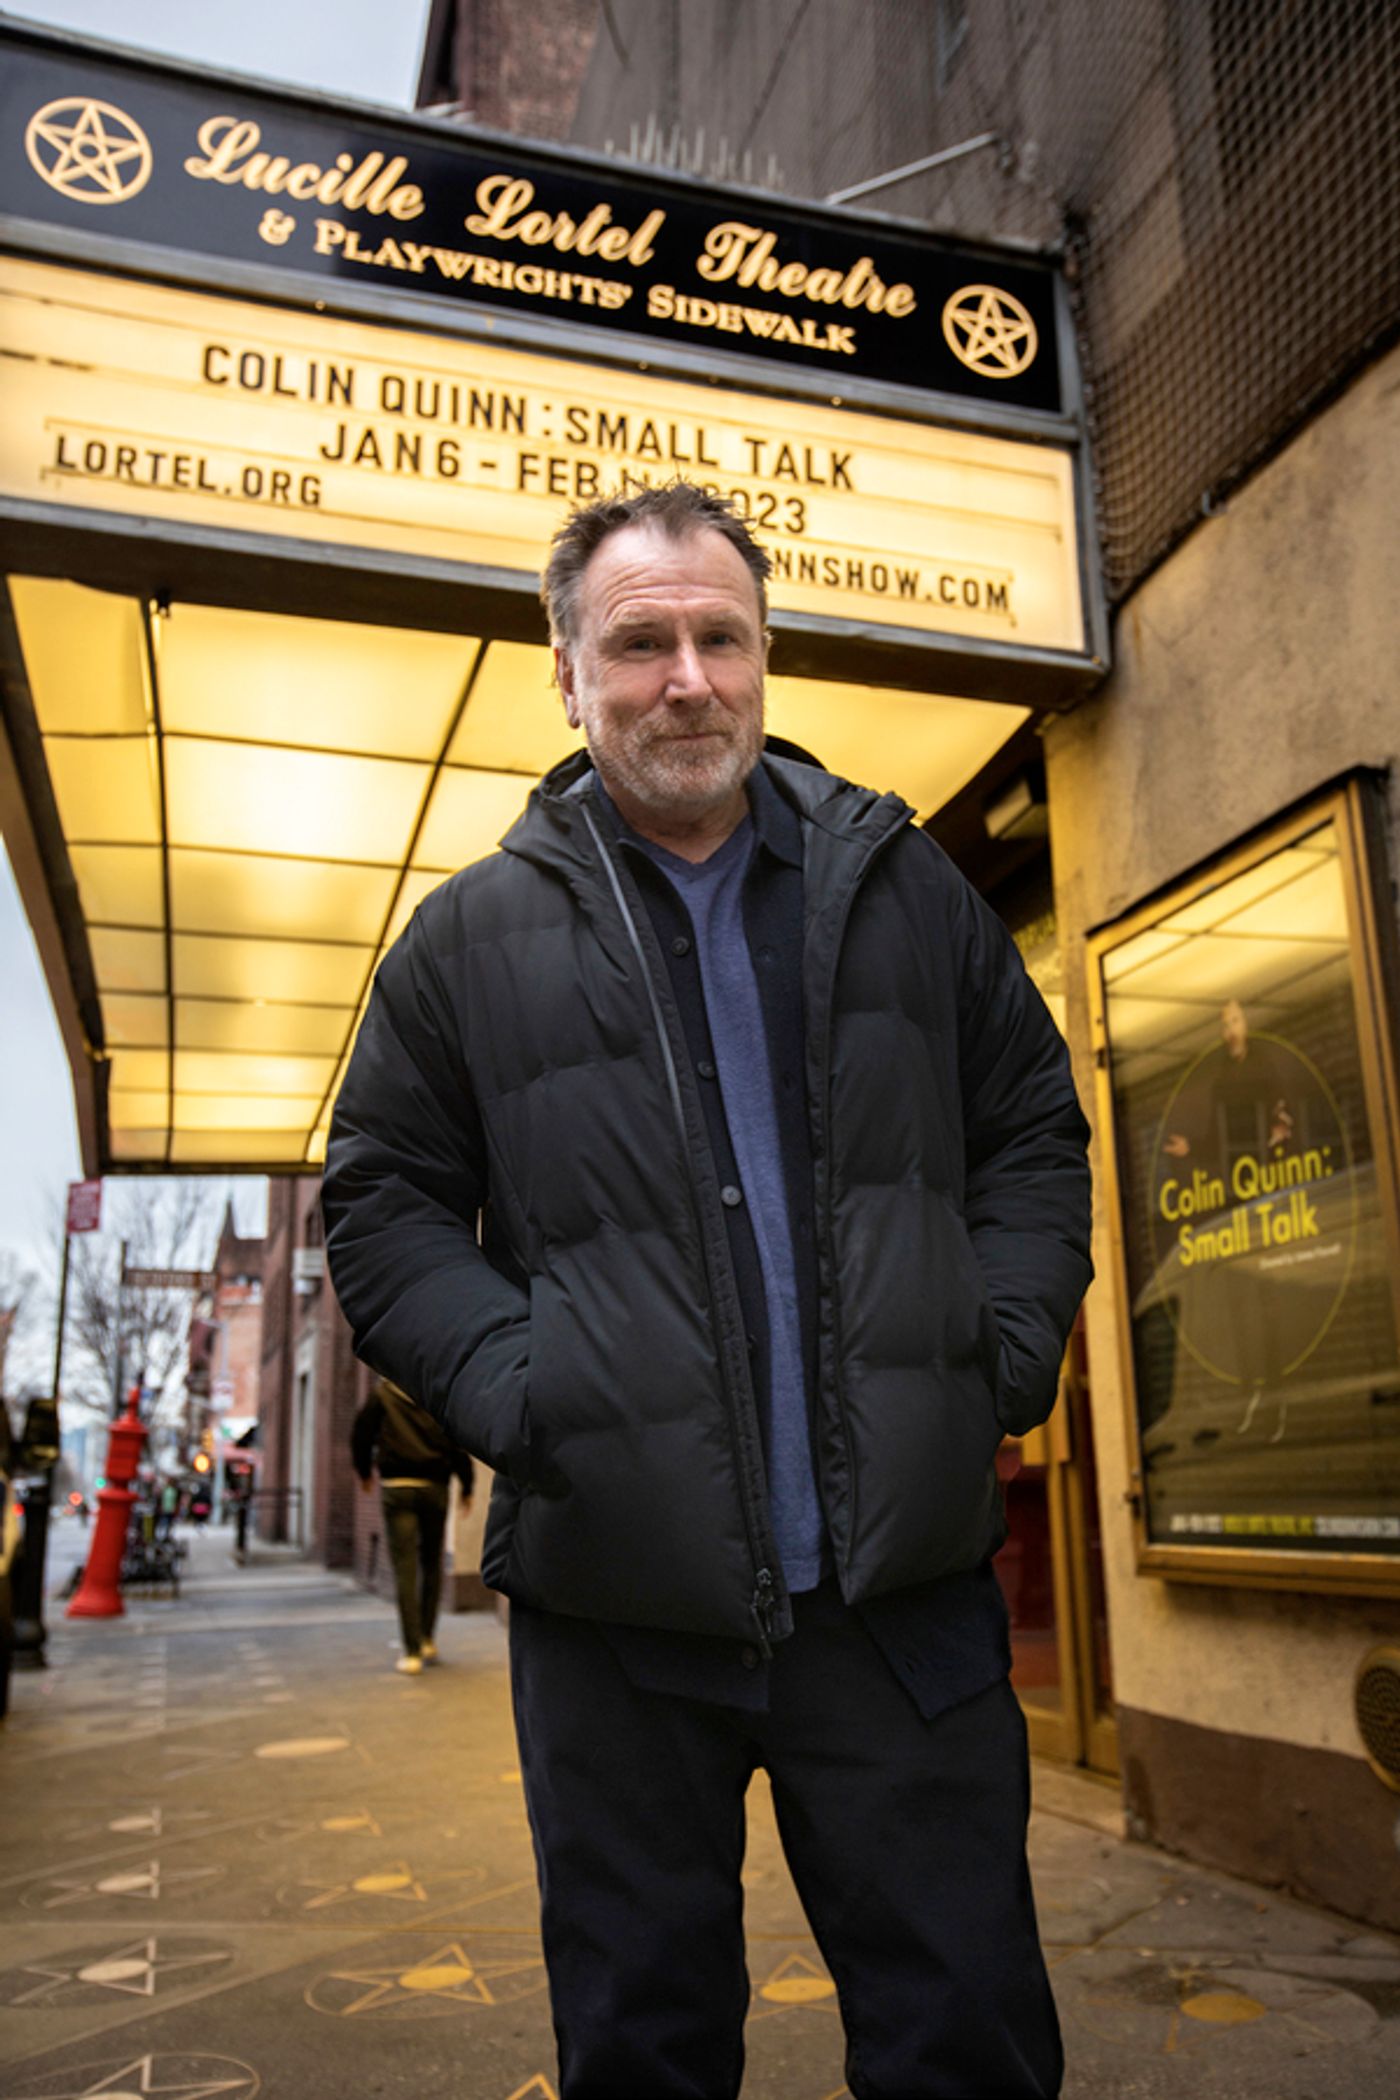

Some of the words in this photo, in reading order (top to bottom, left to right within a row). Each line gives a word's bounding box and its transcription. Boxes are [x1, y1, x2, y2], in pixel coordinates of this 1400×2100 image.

[185, 116, 425, 220] Lucille
[465, 175, 666, 266] Lortel
[696, 221, 917, 318] Theatre
[258, 208, 296, 245] &
[647, 284, 857, 354] SIDEWALK
[203, 345, 353, 405] COLIN
[745, 436, 853, 491] TALK
[56, 435, 321, 507] LORTEL.ORG
[518, 452, 599, 499] FEB
[773, 548, 1010, 612] NNSHOW.COM
[1160, 1168, 1225, 1221] Colin
[1232, 1146, 1333, 1200] Quinn:
[1178, 1206, 1249, 1266] Small
[1256, 1190, 1319, 1247] Talk
